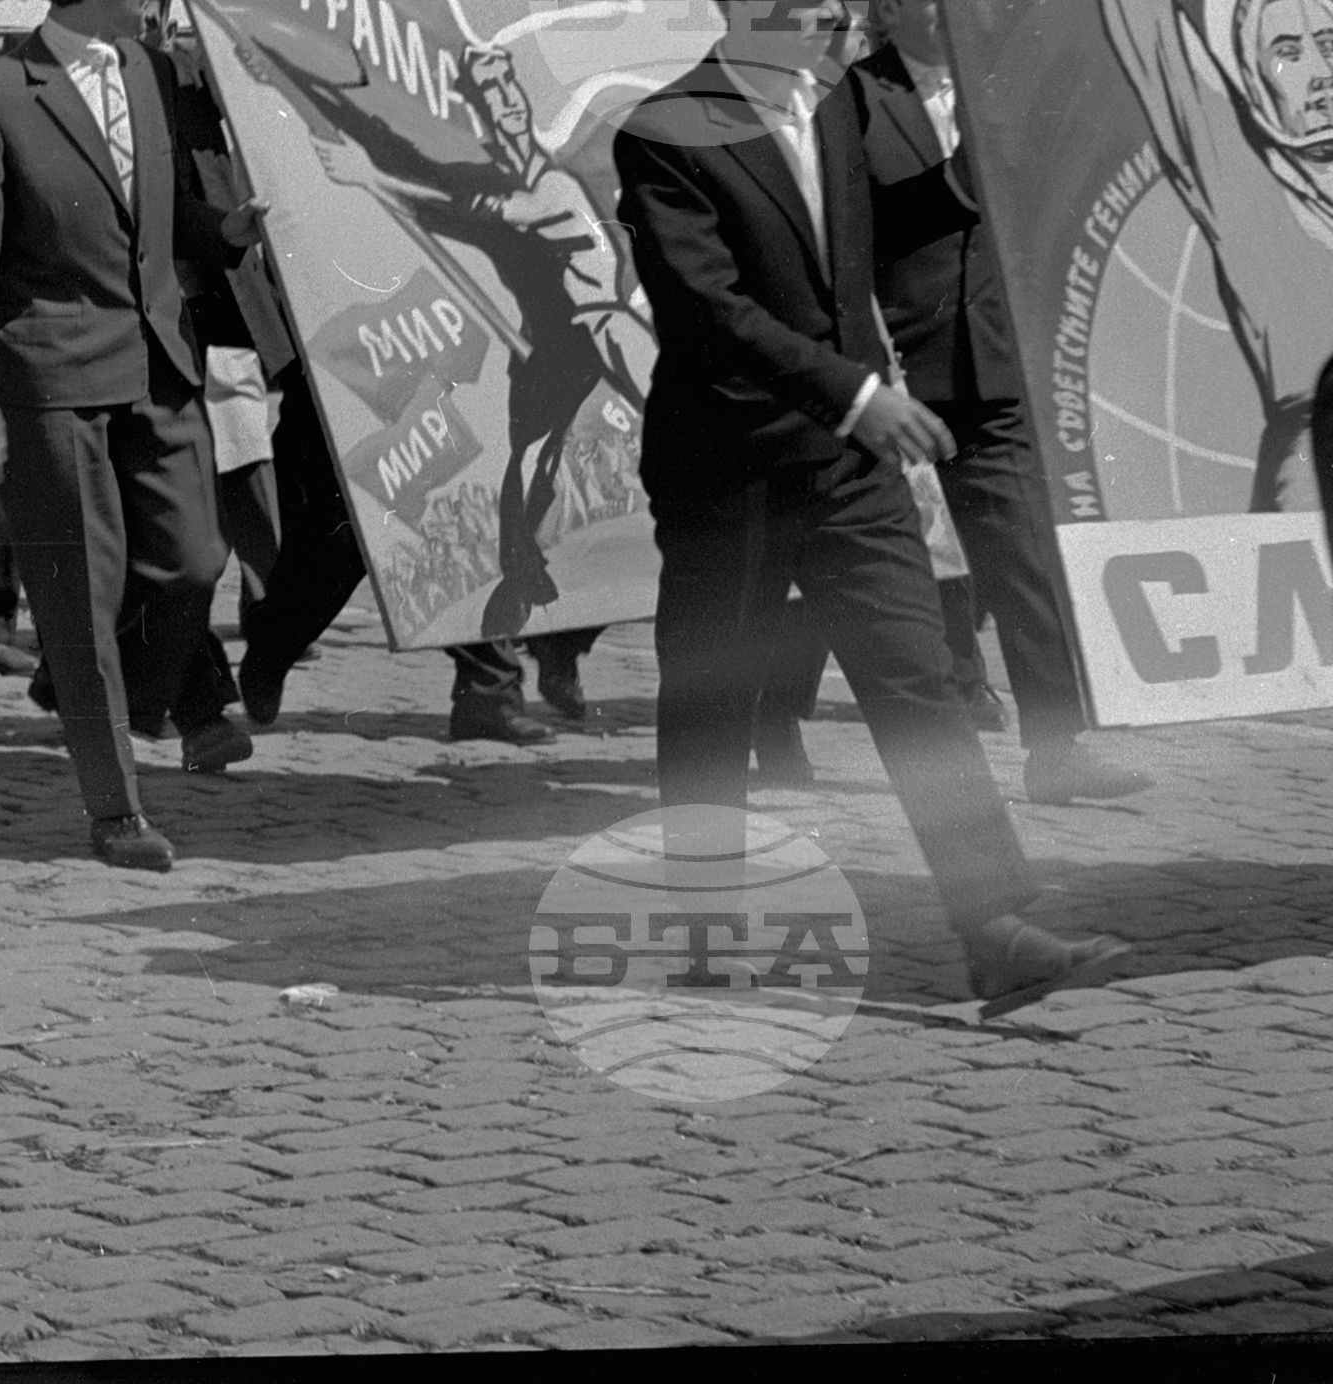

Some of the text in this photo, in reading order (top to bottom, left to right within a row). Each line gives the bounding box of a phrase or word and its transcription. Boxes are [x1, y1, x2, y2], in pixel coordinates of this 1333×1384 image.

[358, 299, 464, 377] МИР
[1052, 140, 1162, 518] НА СОВЕТСКИТЕ ГЕНИИ
[377, 409, 448, 501] МИР
